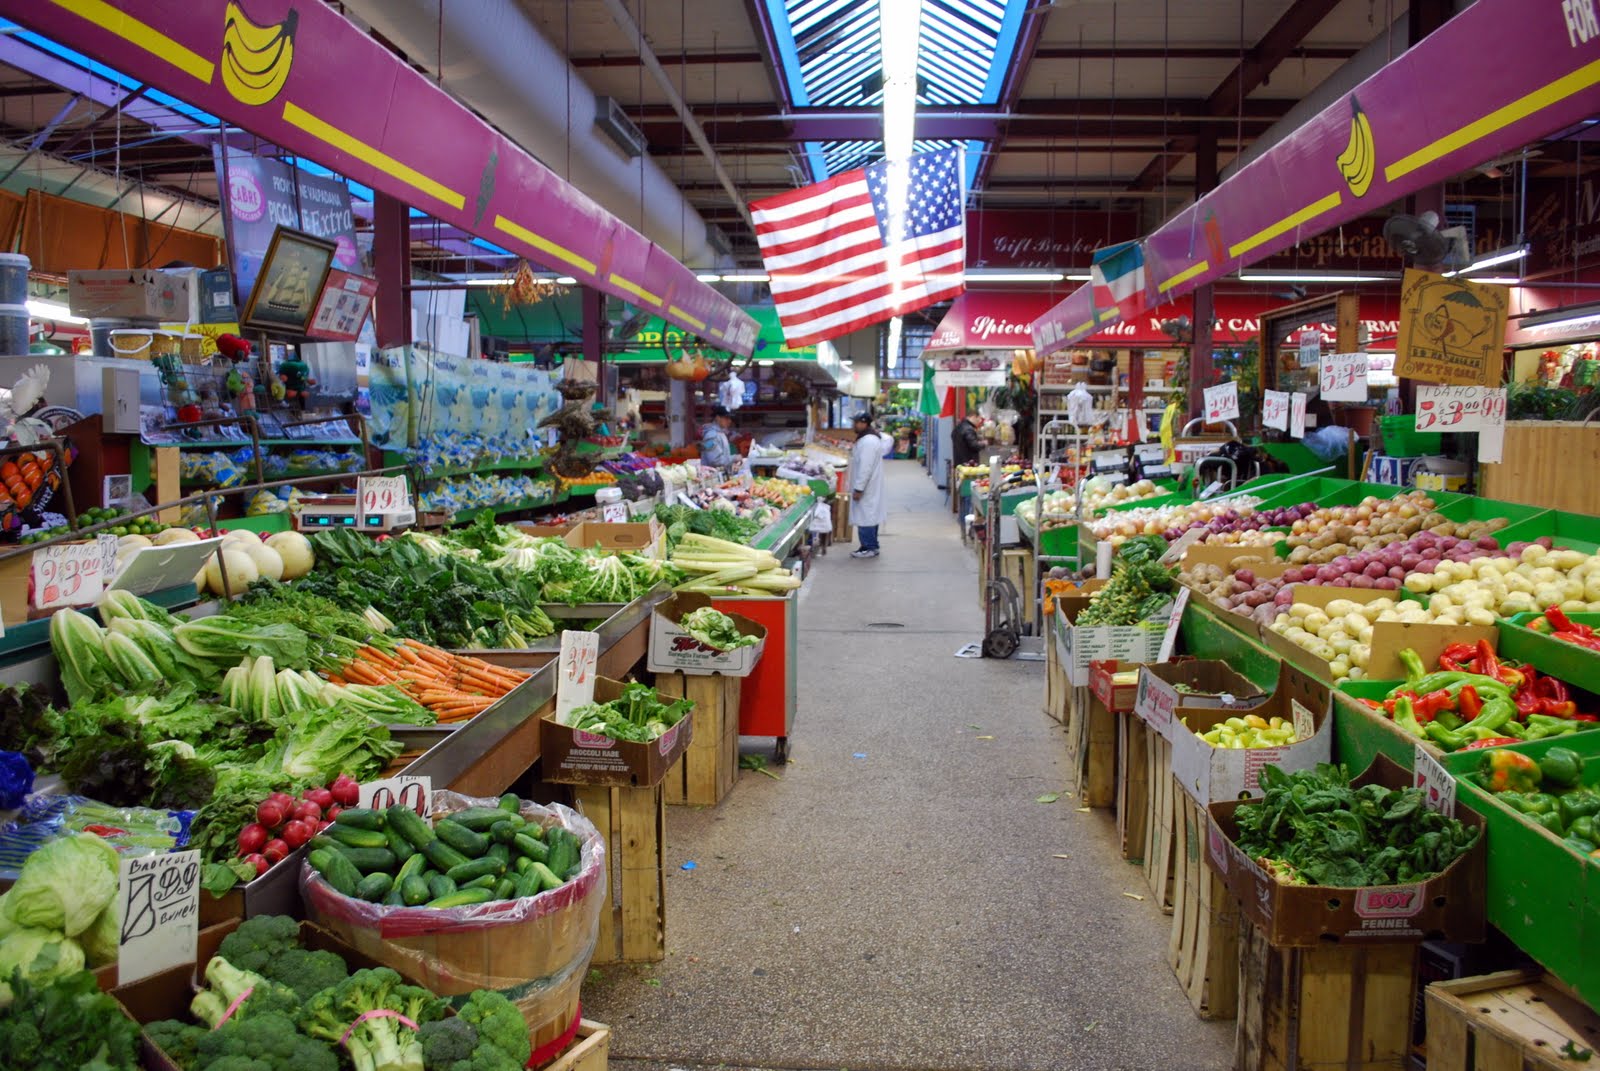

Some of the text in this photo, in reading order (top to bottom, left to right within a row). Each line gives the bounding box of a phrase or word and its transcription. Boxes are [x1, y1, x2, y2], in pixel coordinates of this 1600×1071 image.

[310, 208, 353, 237] Extra
[993, 236, 1032, 258] Gift
[971, 316, 1032, 340] Spices
[1425, 385, 1477, 398] IDAHO
[365, 489, 392, 511] 99
[570, 748, 619, 758] BROCCOLI RABE
[1367, 892, 1415, 909] BOY
[1362, 918, 1410, 928] FENNEL
